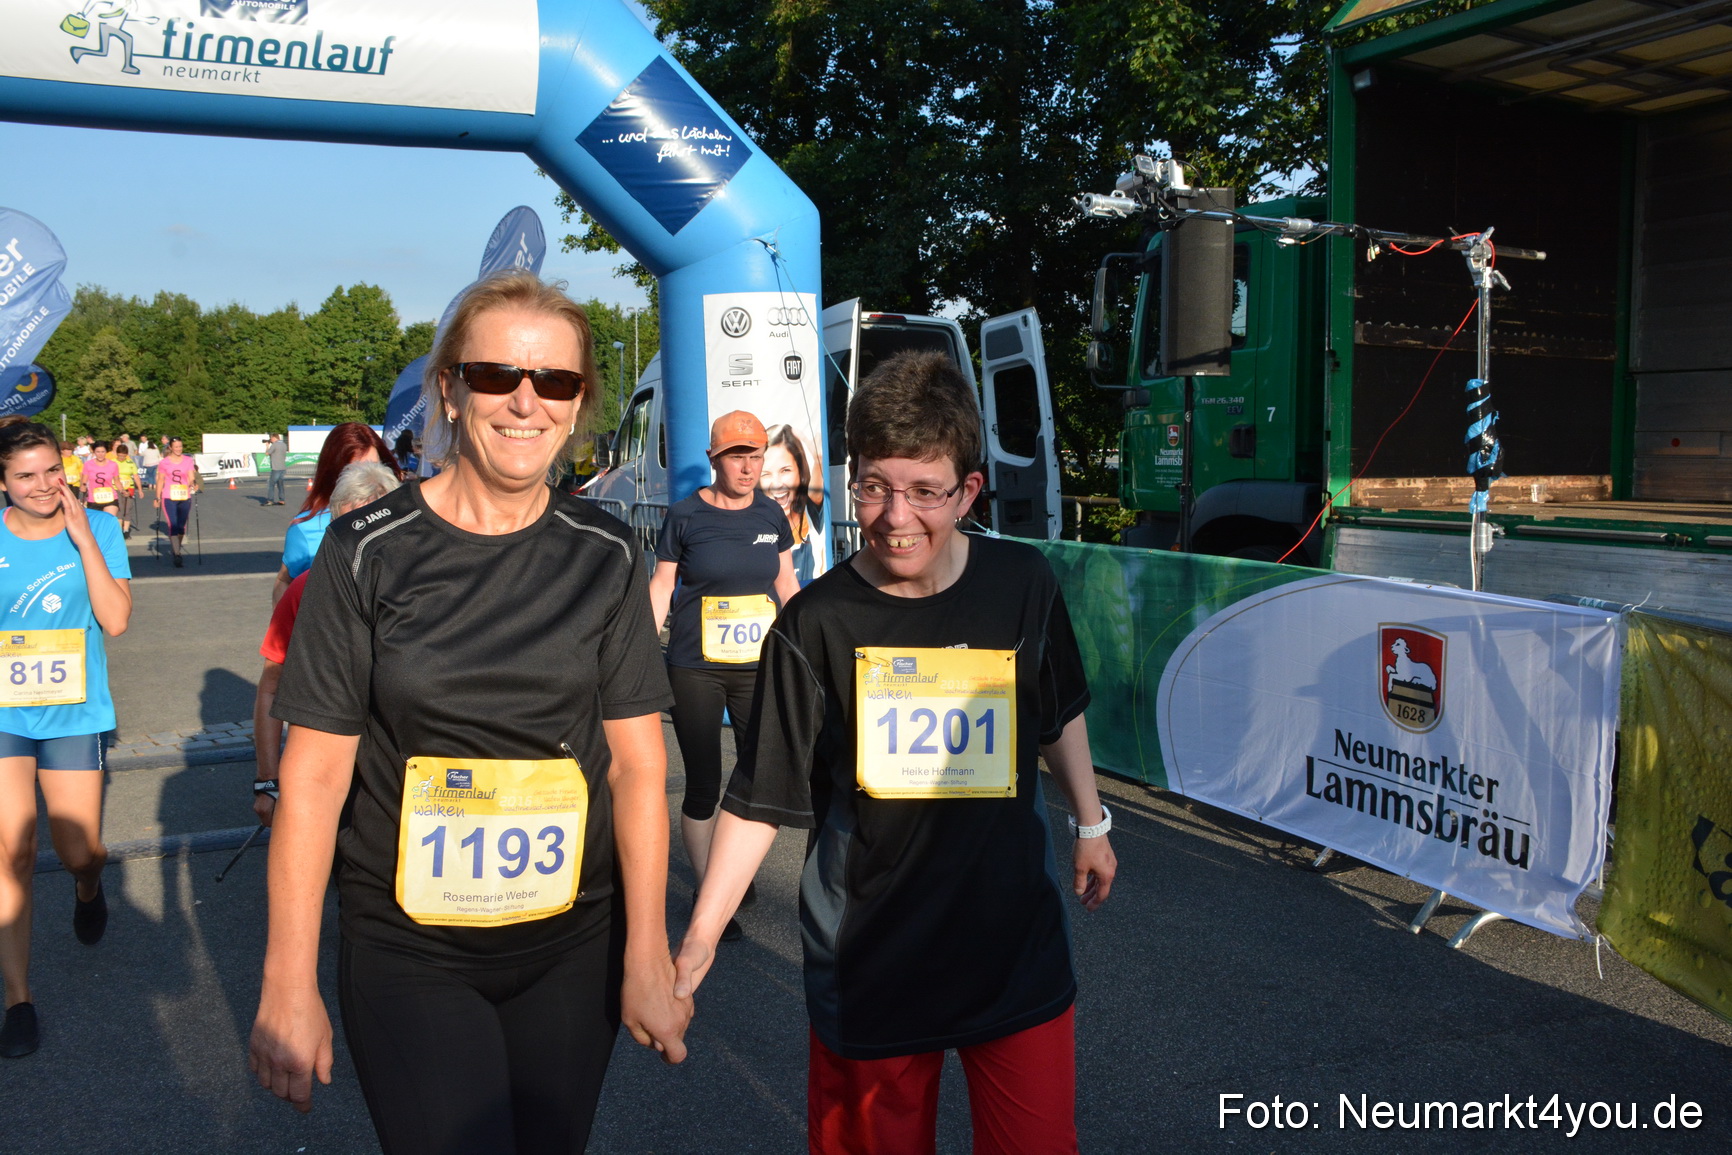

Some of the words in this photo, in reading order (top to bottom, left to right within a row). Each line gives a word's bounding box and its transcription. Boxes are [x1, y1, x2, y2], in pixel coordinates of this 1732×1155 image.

[231, 0, 296, 11] AUTOMOBILE
[162, 17, 397, 76] firmenlauf
[162, 65, 261, 83] neumarkt
[618, 126, 648, 143] und
[681, 125, 733, 141] Lächeln
[700, 144, 731, 158] mit!
[786, 360, 802, 375] FIAT
[721, 379, 761, 388] SEAT
[1267, 406, 1276, 422] 7
[365, 508, 392, 524] JAKO
[10, 592, 29, 614] Team
[26, 571, 56, 592] Schick
[56, 562, 76, 573] Bau
[717, 622, 762, 645] 760
[10, 660, 67, 686] 815
[883, 672, 939, 684] firmenlauf
[940, 680, 969, 690] 2016
[867, 688, 913, 700] walken
[1396, 704, 1426, 723] 1628
[877, 707, 995, 755] 1201
[901, 766, 930, 776] Heike
[931, 767, 975, 776] Hoffmann
[1334, 728, 1499, 804] Neumarkter
[434, 786, 498, 800] firmenlauf
[499, 795, 533, 807] 2016
[414, 803, 465, 818] walken
[1306, 755, 1530, 871] Lammsbräu
[421, 825, 565, 880] 1193
[443, 891, 504, 903] Rosemarie
[505, 890, 538, 900] Weber
